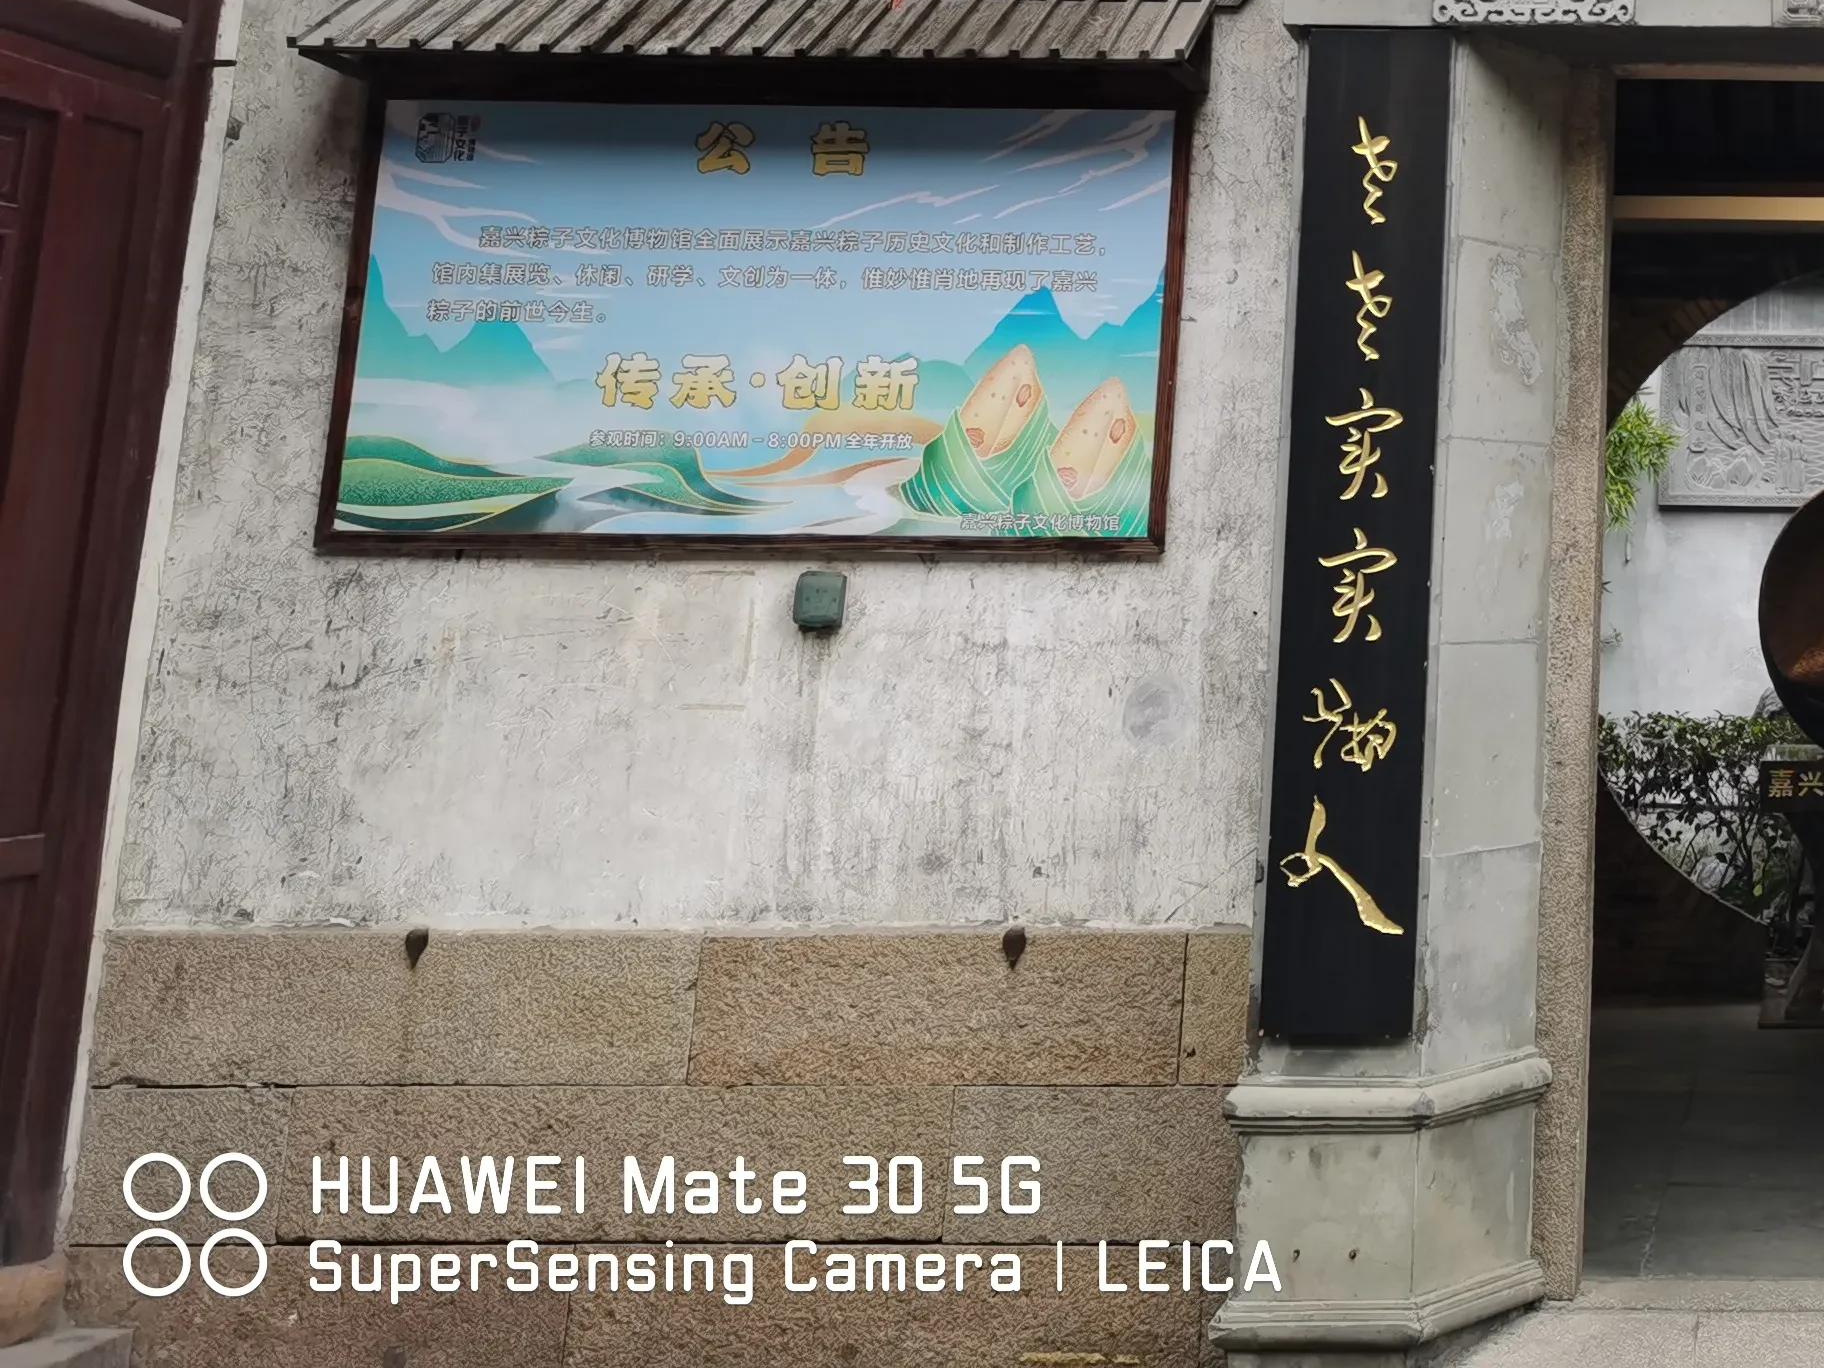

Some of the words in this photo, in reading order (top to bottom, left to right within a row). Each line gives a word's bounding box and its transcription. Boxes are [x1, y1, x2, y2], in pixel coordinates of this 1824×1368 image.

[694, 120, 871, 177] 公告
[426, 299, 607, 325] 粽子的前世今生。
[960, 513, 1121, 532] 嘉兴粽子文化博物馆
